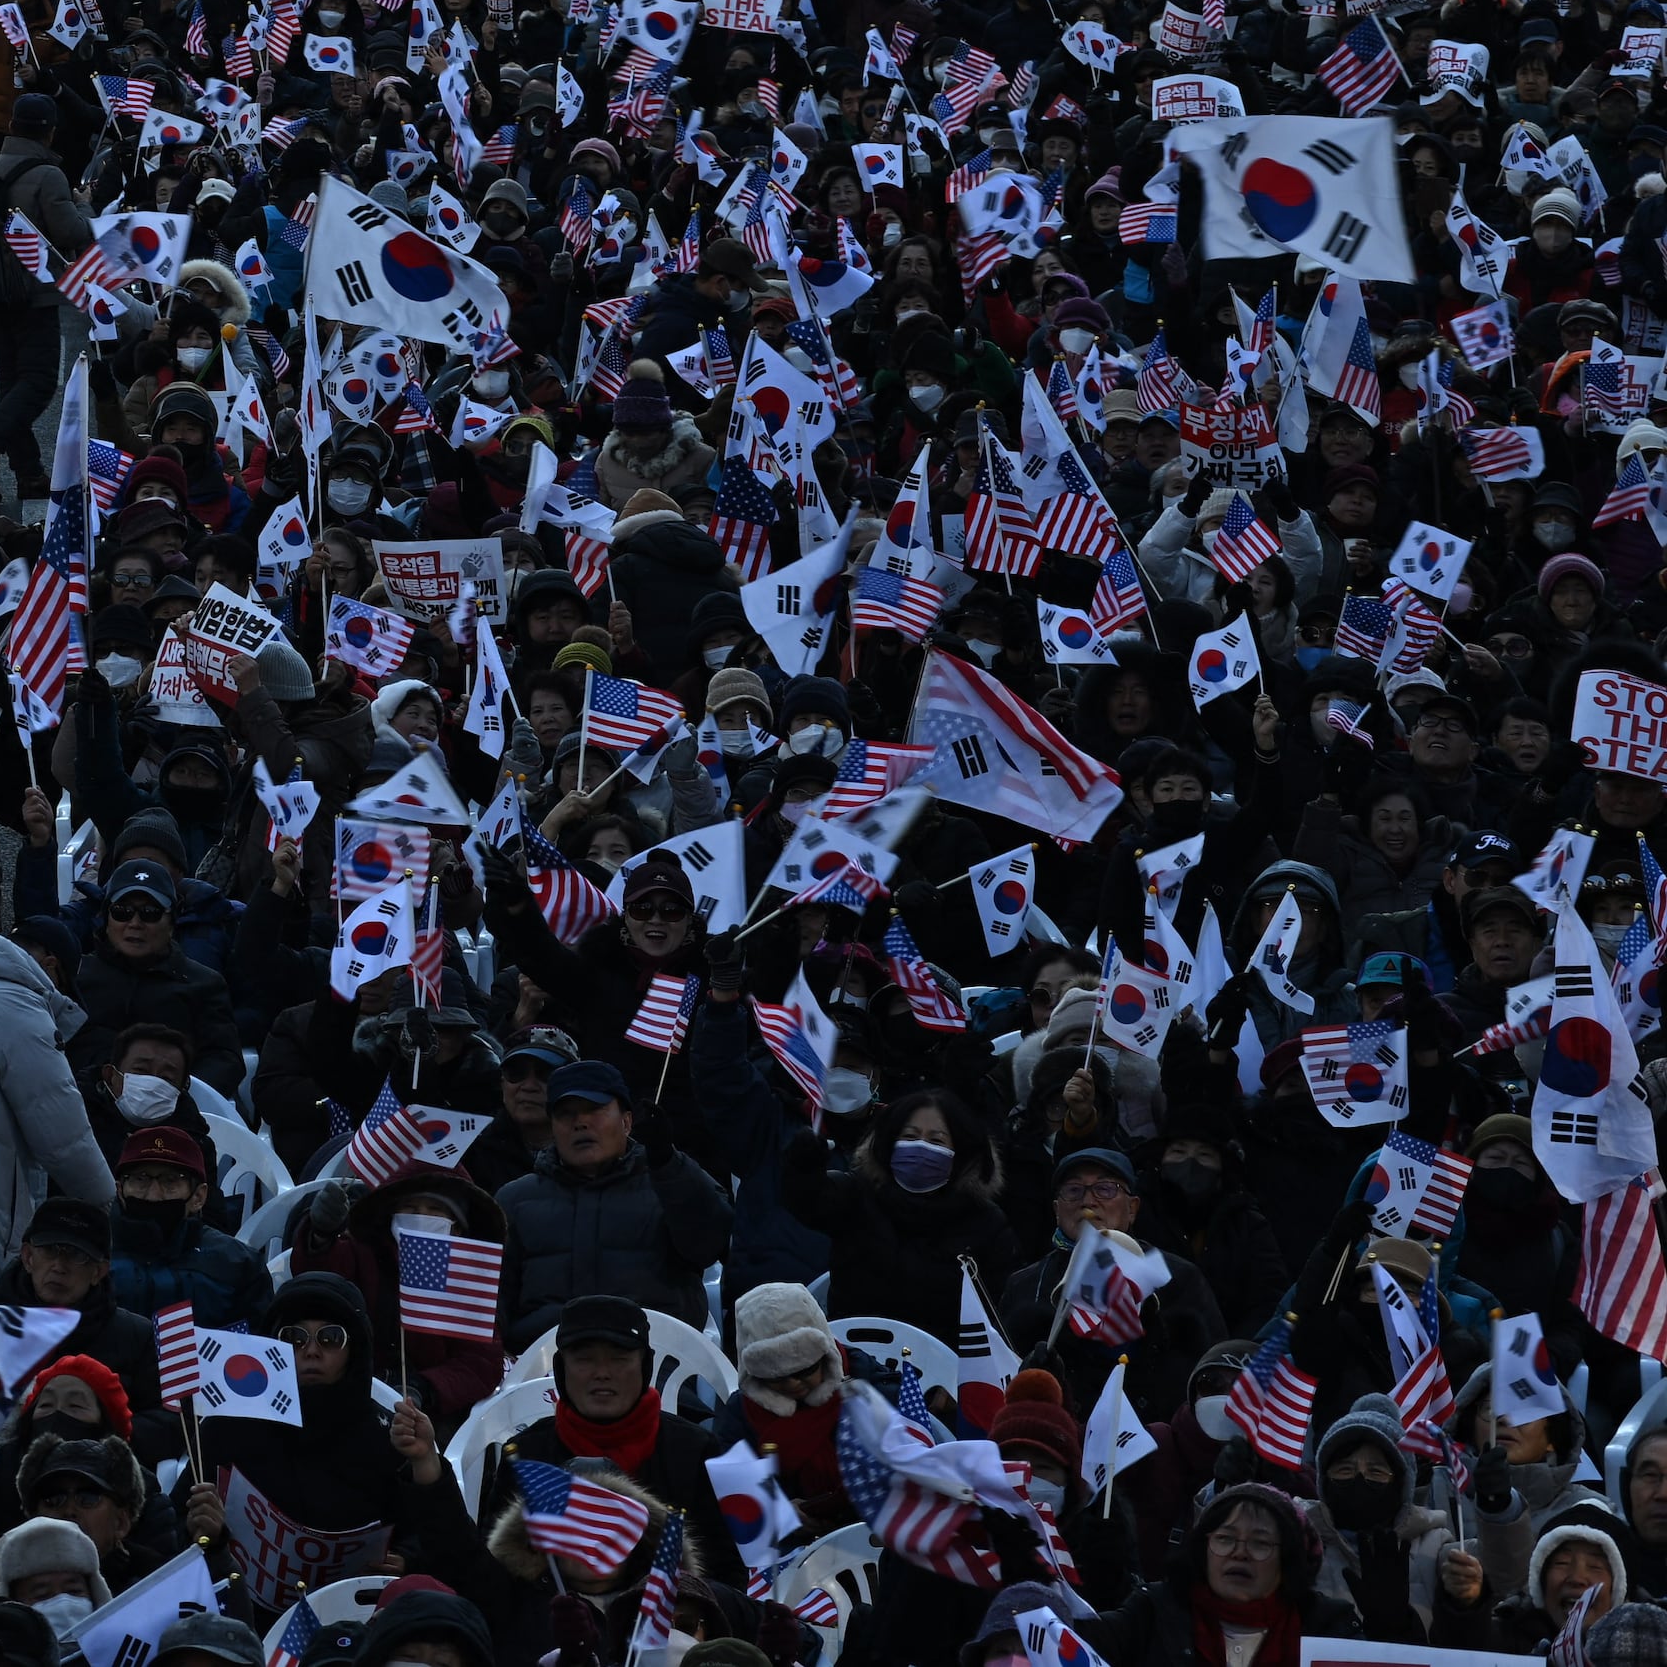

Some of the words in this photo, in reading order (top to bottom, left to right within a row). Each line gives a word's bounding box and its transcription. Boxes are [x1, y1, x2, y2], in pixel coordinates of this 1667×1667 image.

[707, 8, 777, 32] STEAL
[1165, 14, 1195, 35] 윤석열
[1158, 85, 1199, 102] 윤석열
[1158, 100, 1215, 117] 대통령과
[1184, 405, 1270, 441] 부정선거
[1209, 441, 1258, 459] OUT
[383, 556, 436, 576] 윤석열
[389, 577, 457, 597] 대통령과
[245, 1494, 362, 1564] STOP
